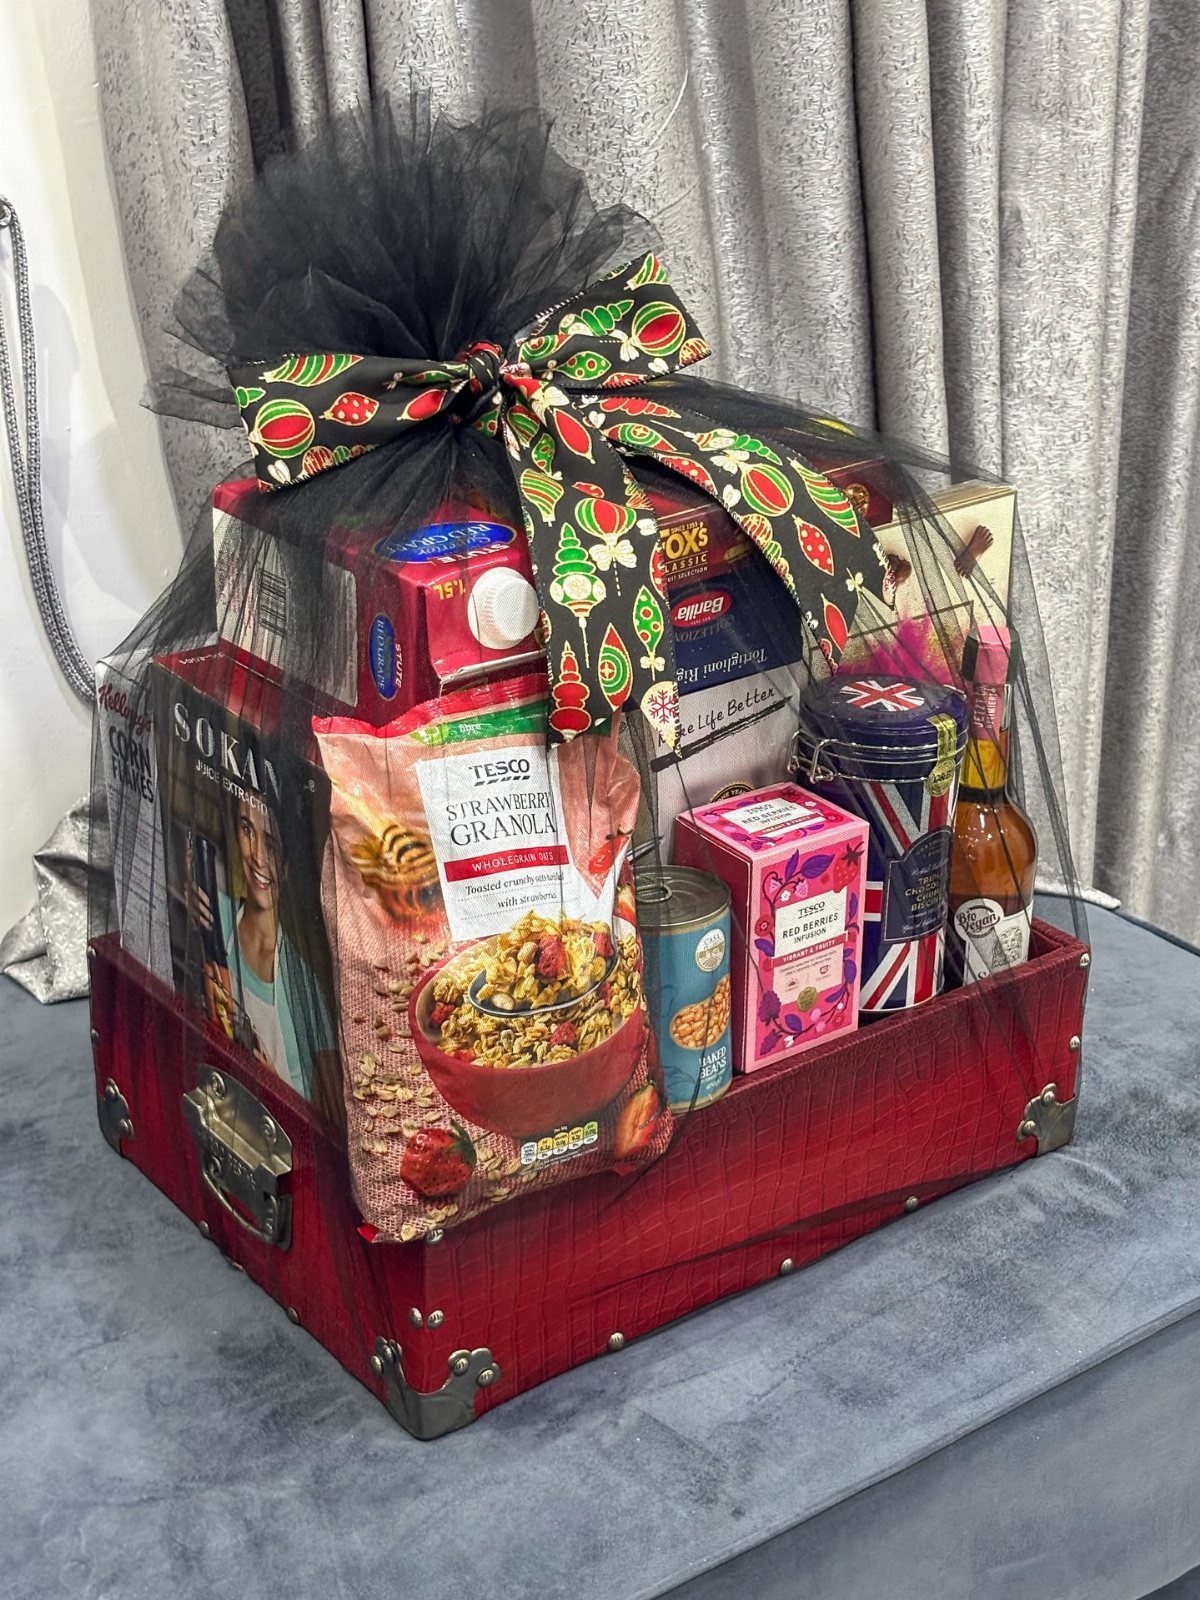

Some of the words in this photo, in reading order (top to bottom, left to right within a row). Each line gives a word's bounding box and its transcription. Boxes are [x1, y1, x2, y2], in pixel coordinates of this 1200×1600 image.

[448, 523, 492, 539] RED
[437, 543, 510, 564] STUTE
[664, 554, 707, 573] LASSIC
[678, 566, 708, 579] SELECTION
[433, 578, 467, 600] 1.5L
[677, 596, 724, 621] Barilla
[674, 614, 735, 642] COLLEZION
[395, 643, 403, 688] STUTE
[676, 666, 699, 684] Rig
[700, 648, 768, 680] Tortiglioni
[658, 722, 695, 747] Mke
[698, 710, 725, 730] Life
[727, 687, 776, 717] Better
[109, 725, 152, 778] CORN
[174, 702, 281, 801] SOKAN
[112, 754, 154, 804] FLAKES
[469, 758, 531, 780] TESCO
[195, 759, 220, 784] JUICE
[222, 777, 269, 815] EXTRACTO
[446, 792, 552, 821] STRAWBERRY
[450, 812, 557, 846] GRANOLA
[472, 853, 537, 872] WHOLEGRAIN
[539, 851, 554, 861] OATS
[466, 881, 501, 896] Toasted
[503, 873, 535, 888] crunchy
[497, 896, 518, 909] with
[798, 901, 826, 915] TESCO
[782, 926, 801, 939] RED
[803, 912, 839, 931] BERRIES
[956, 910, 977, 924] Bio
[959, 913, 997, 933] Vegan
[794, 927, 827, 944] INFUSION
[783, 951, 808, 963] VIBRANT
[815, 940, 836, 952] FRUITY
[700, 1056, 727, 1079] BEANS
